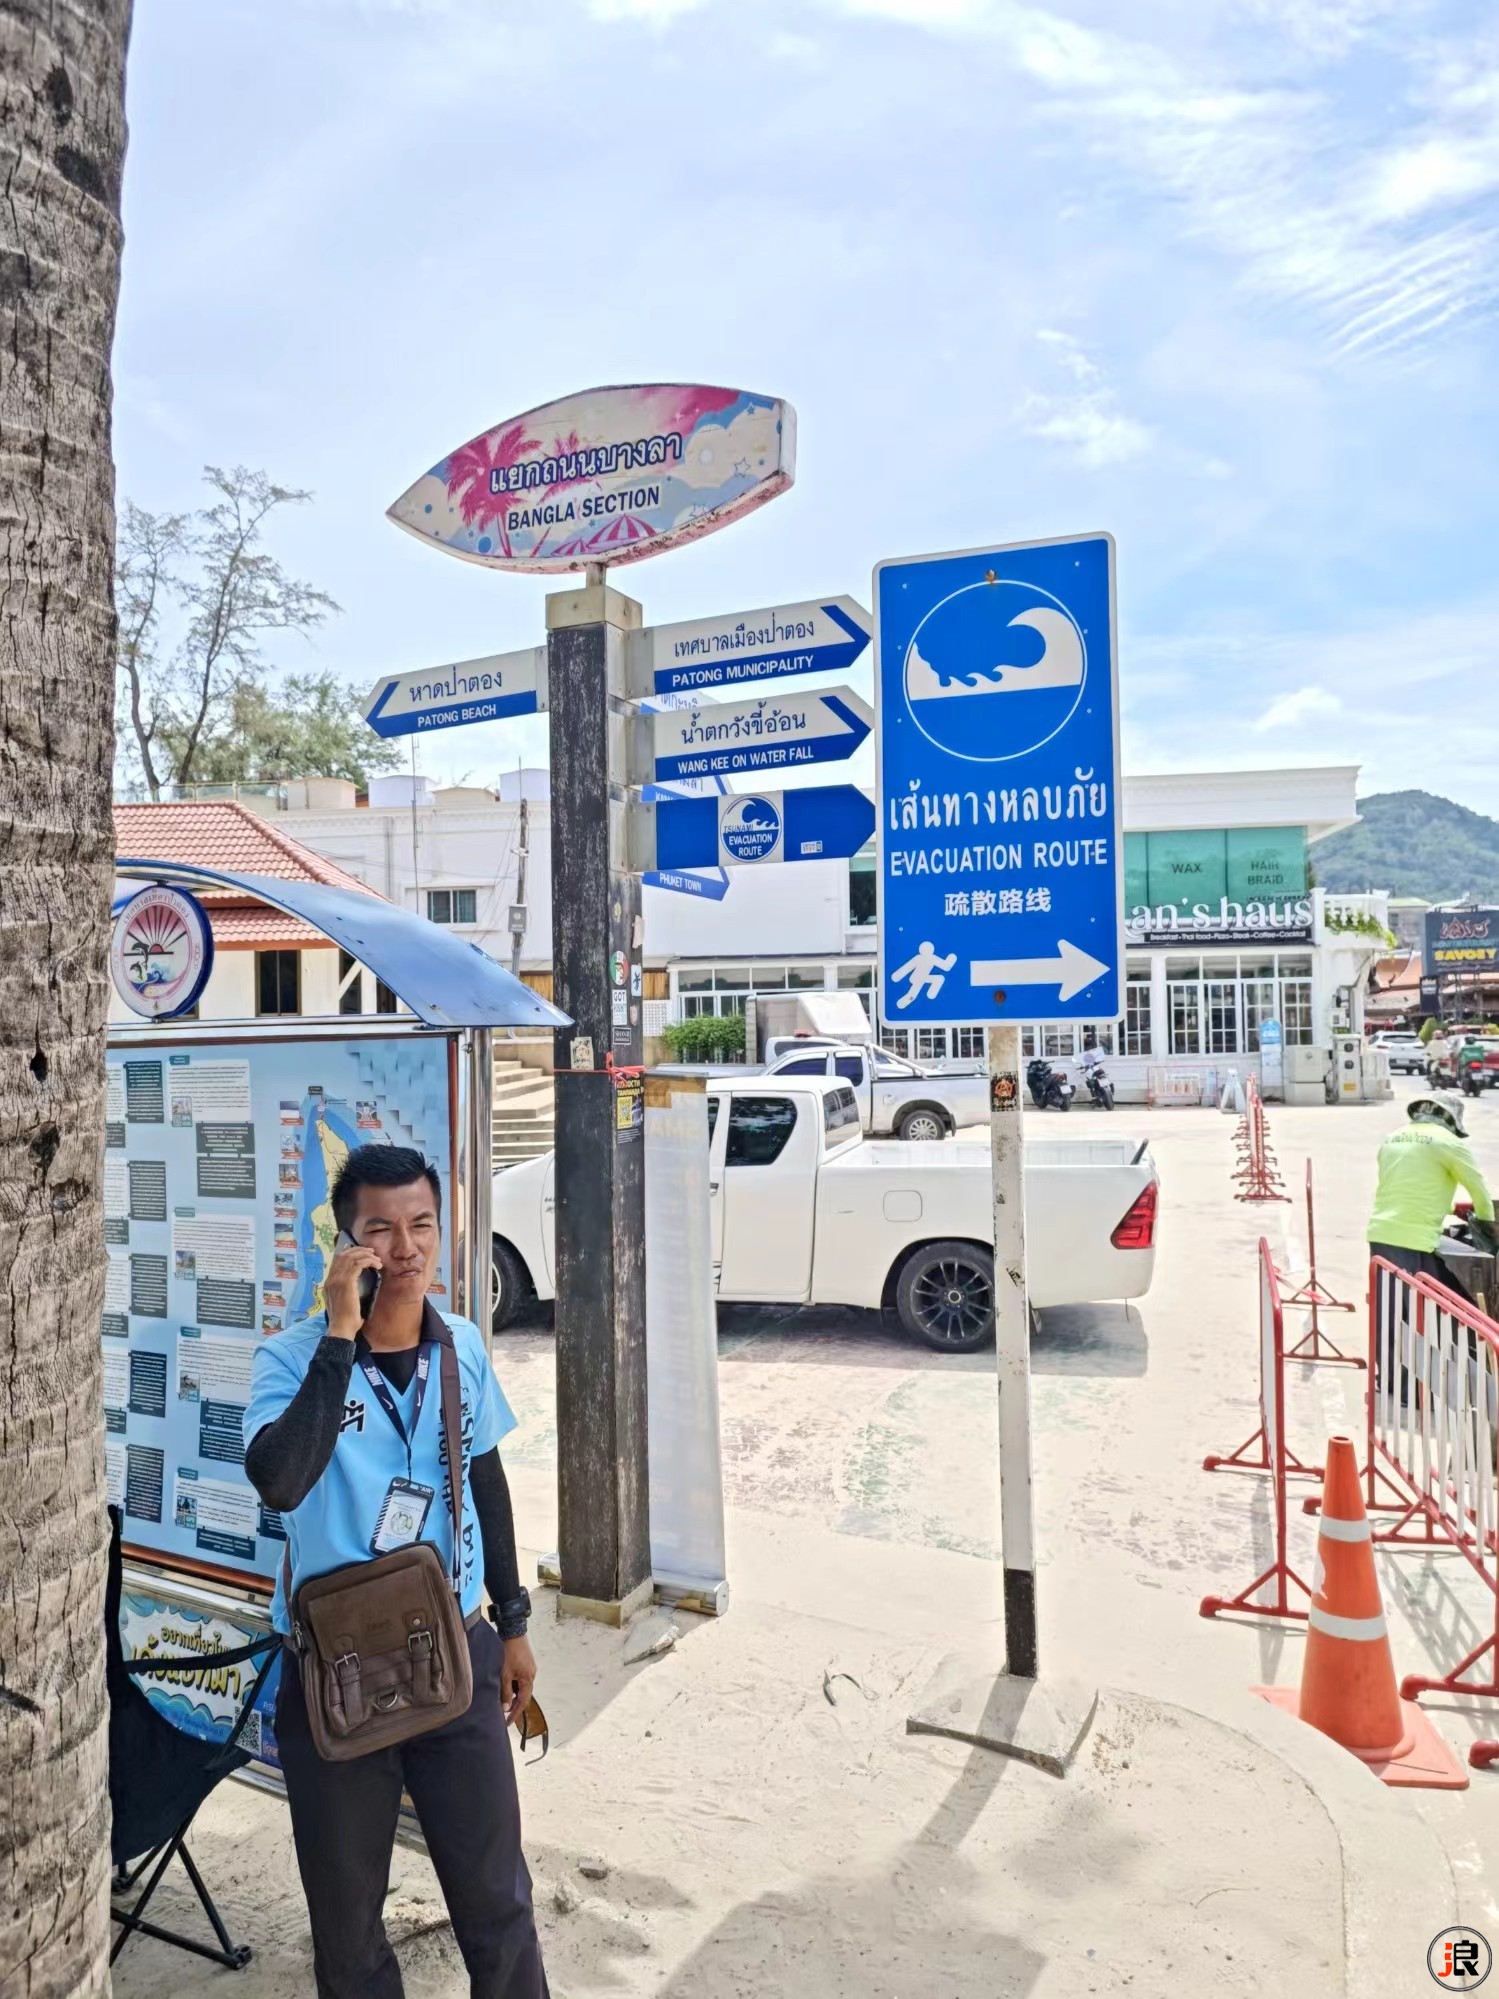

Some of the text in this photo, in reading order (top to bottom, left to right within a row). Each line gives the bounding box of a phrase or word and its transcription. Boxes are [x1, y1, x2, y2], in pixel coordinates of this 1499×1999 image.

[489, 431, 684, 495] แยกถนนบางลา
[507, 487, 660, 532] BANGLA SECTION
[674, 613, 815, 658] เทศบาลเมืองป่าตอง
[409, 666, 502, 703] หาดป่าตอง
[672, 655, 814, 688] PATONG MUNICIPALITY
[417, 703, 497, 728] PATONG BEACH
[681, 701, 807, 746] น้ำตกวังขี้อ้อน
[678, 745, 814, 774] WANG KEE ON WATER FALL
[890, 766, 1107, 831] เส้นทางหลบภัย
[723, 823, 754, 834] TSUNAMI
[728, 833, 773, 846] EVACUATION
[738, 846, 763, 857] ROUTE
[891, 838, 1107, 876] EVACUATION ROUTE
[659, 873, 702, 893] PHUKET TOWN
[1171, 863, 1202, 875] WAX
[944, 887, 1052, 917] 疏散路线
[1219, 896, 1313, 930] haus
[613, 991, 626, 1002] GOT
[363, 1366, 384, 1387] NIKE
[417, 1357, 429, 1380] NIKE
